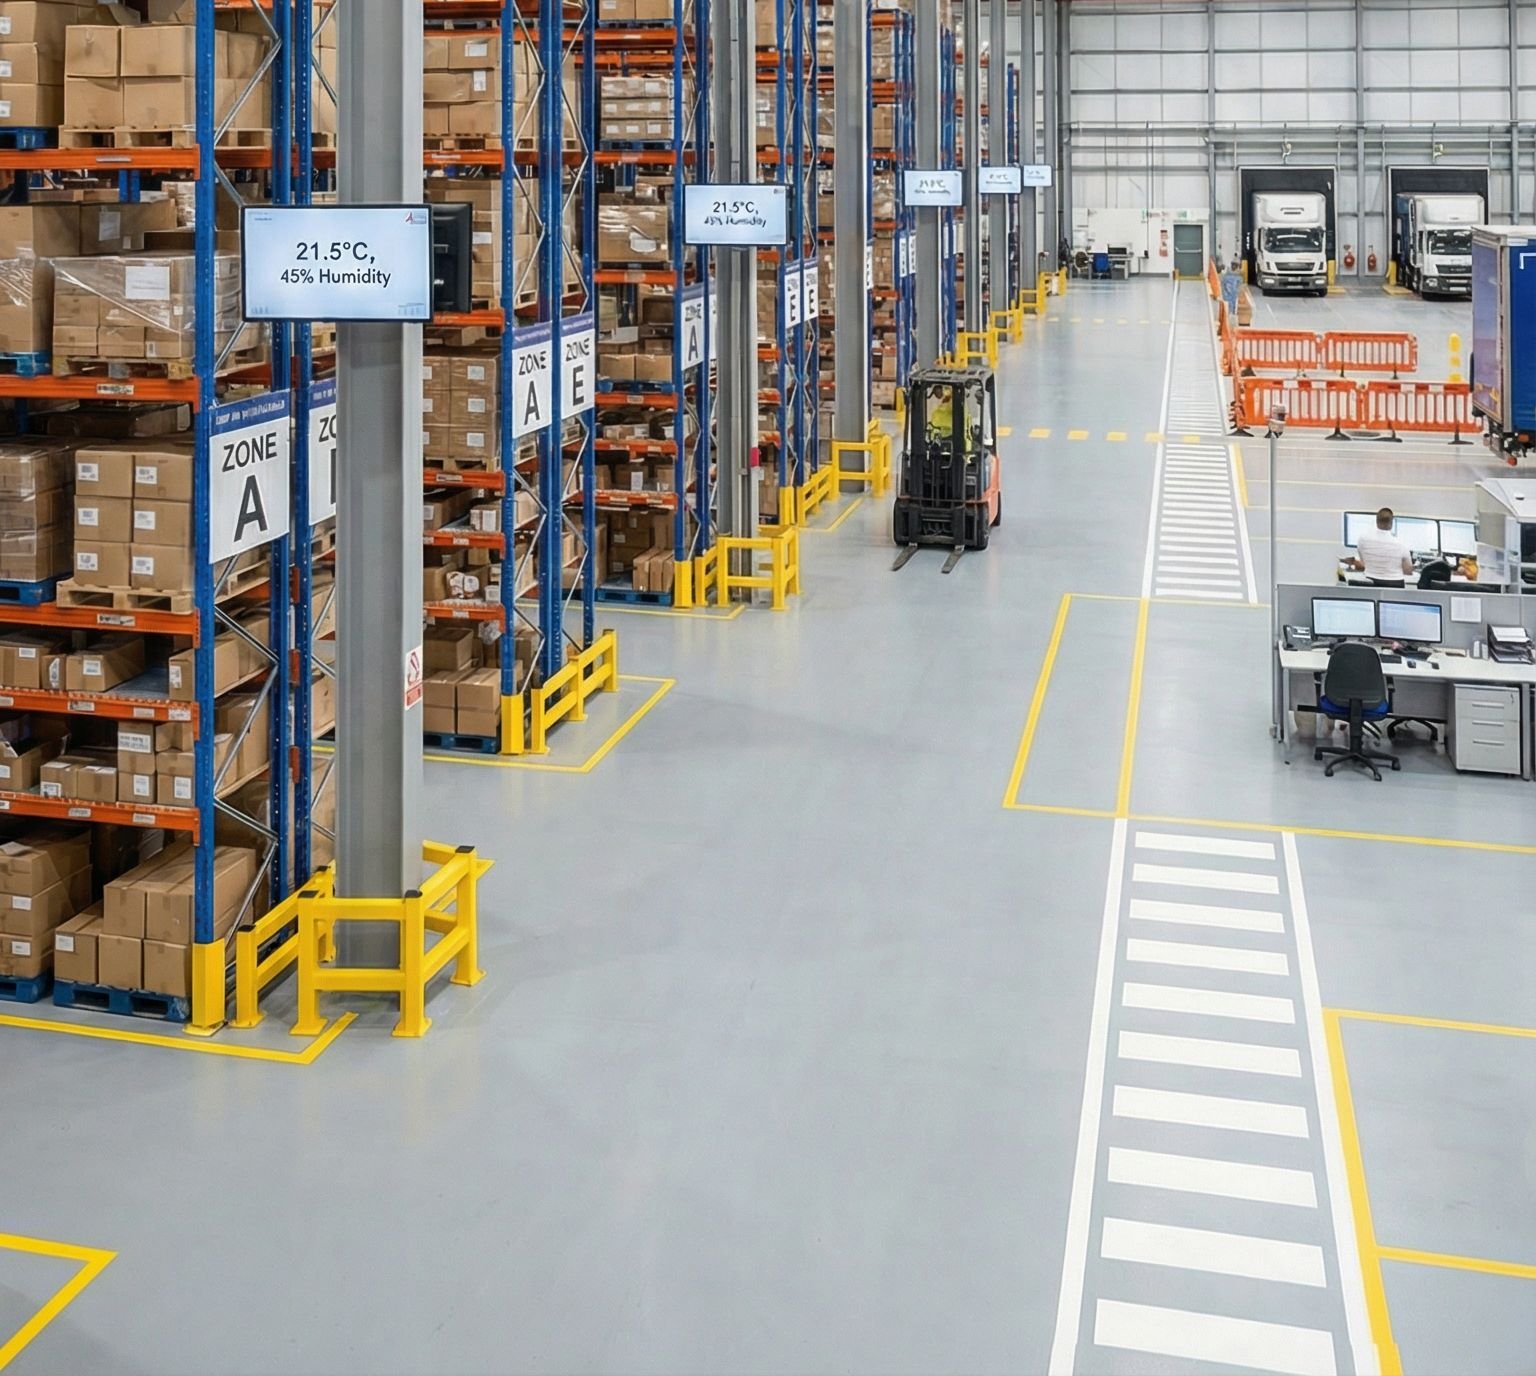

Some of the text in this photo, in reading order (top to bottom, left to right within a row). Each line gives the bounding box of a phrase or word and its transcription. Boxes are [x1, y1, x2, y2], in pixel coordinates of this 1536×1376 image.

[296, 241, 376, 264] 21.5°C,
[280, 267, 391, 288] 45% Humidity
[688, 324, 699, 362] A
[519, 350, 547, 376] ZONE
[523, 380, 540, 425] A
[573, 365, 585, 406] E
[222, 432, 278, 473] ZONE
[233, 474, 268, 543] A
